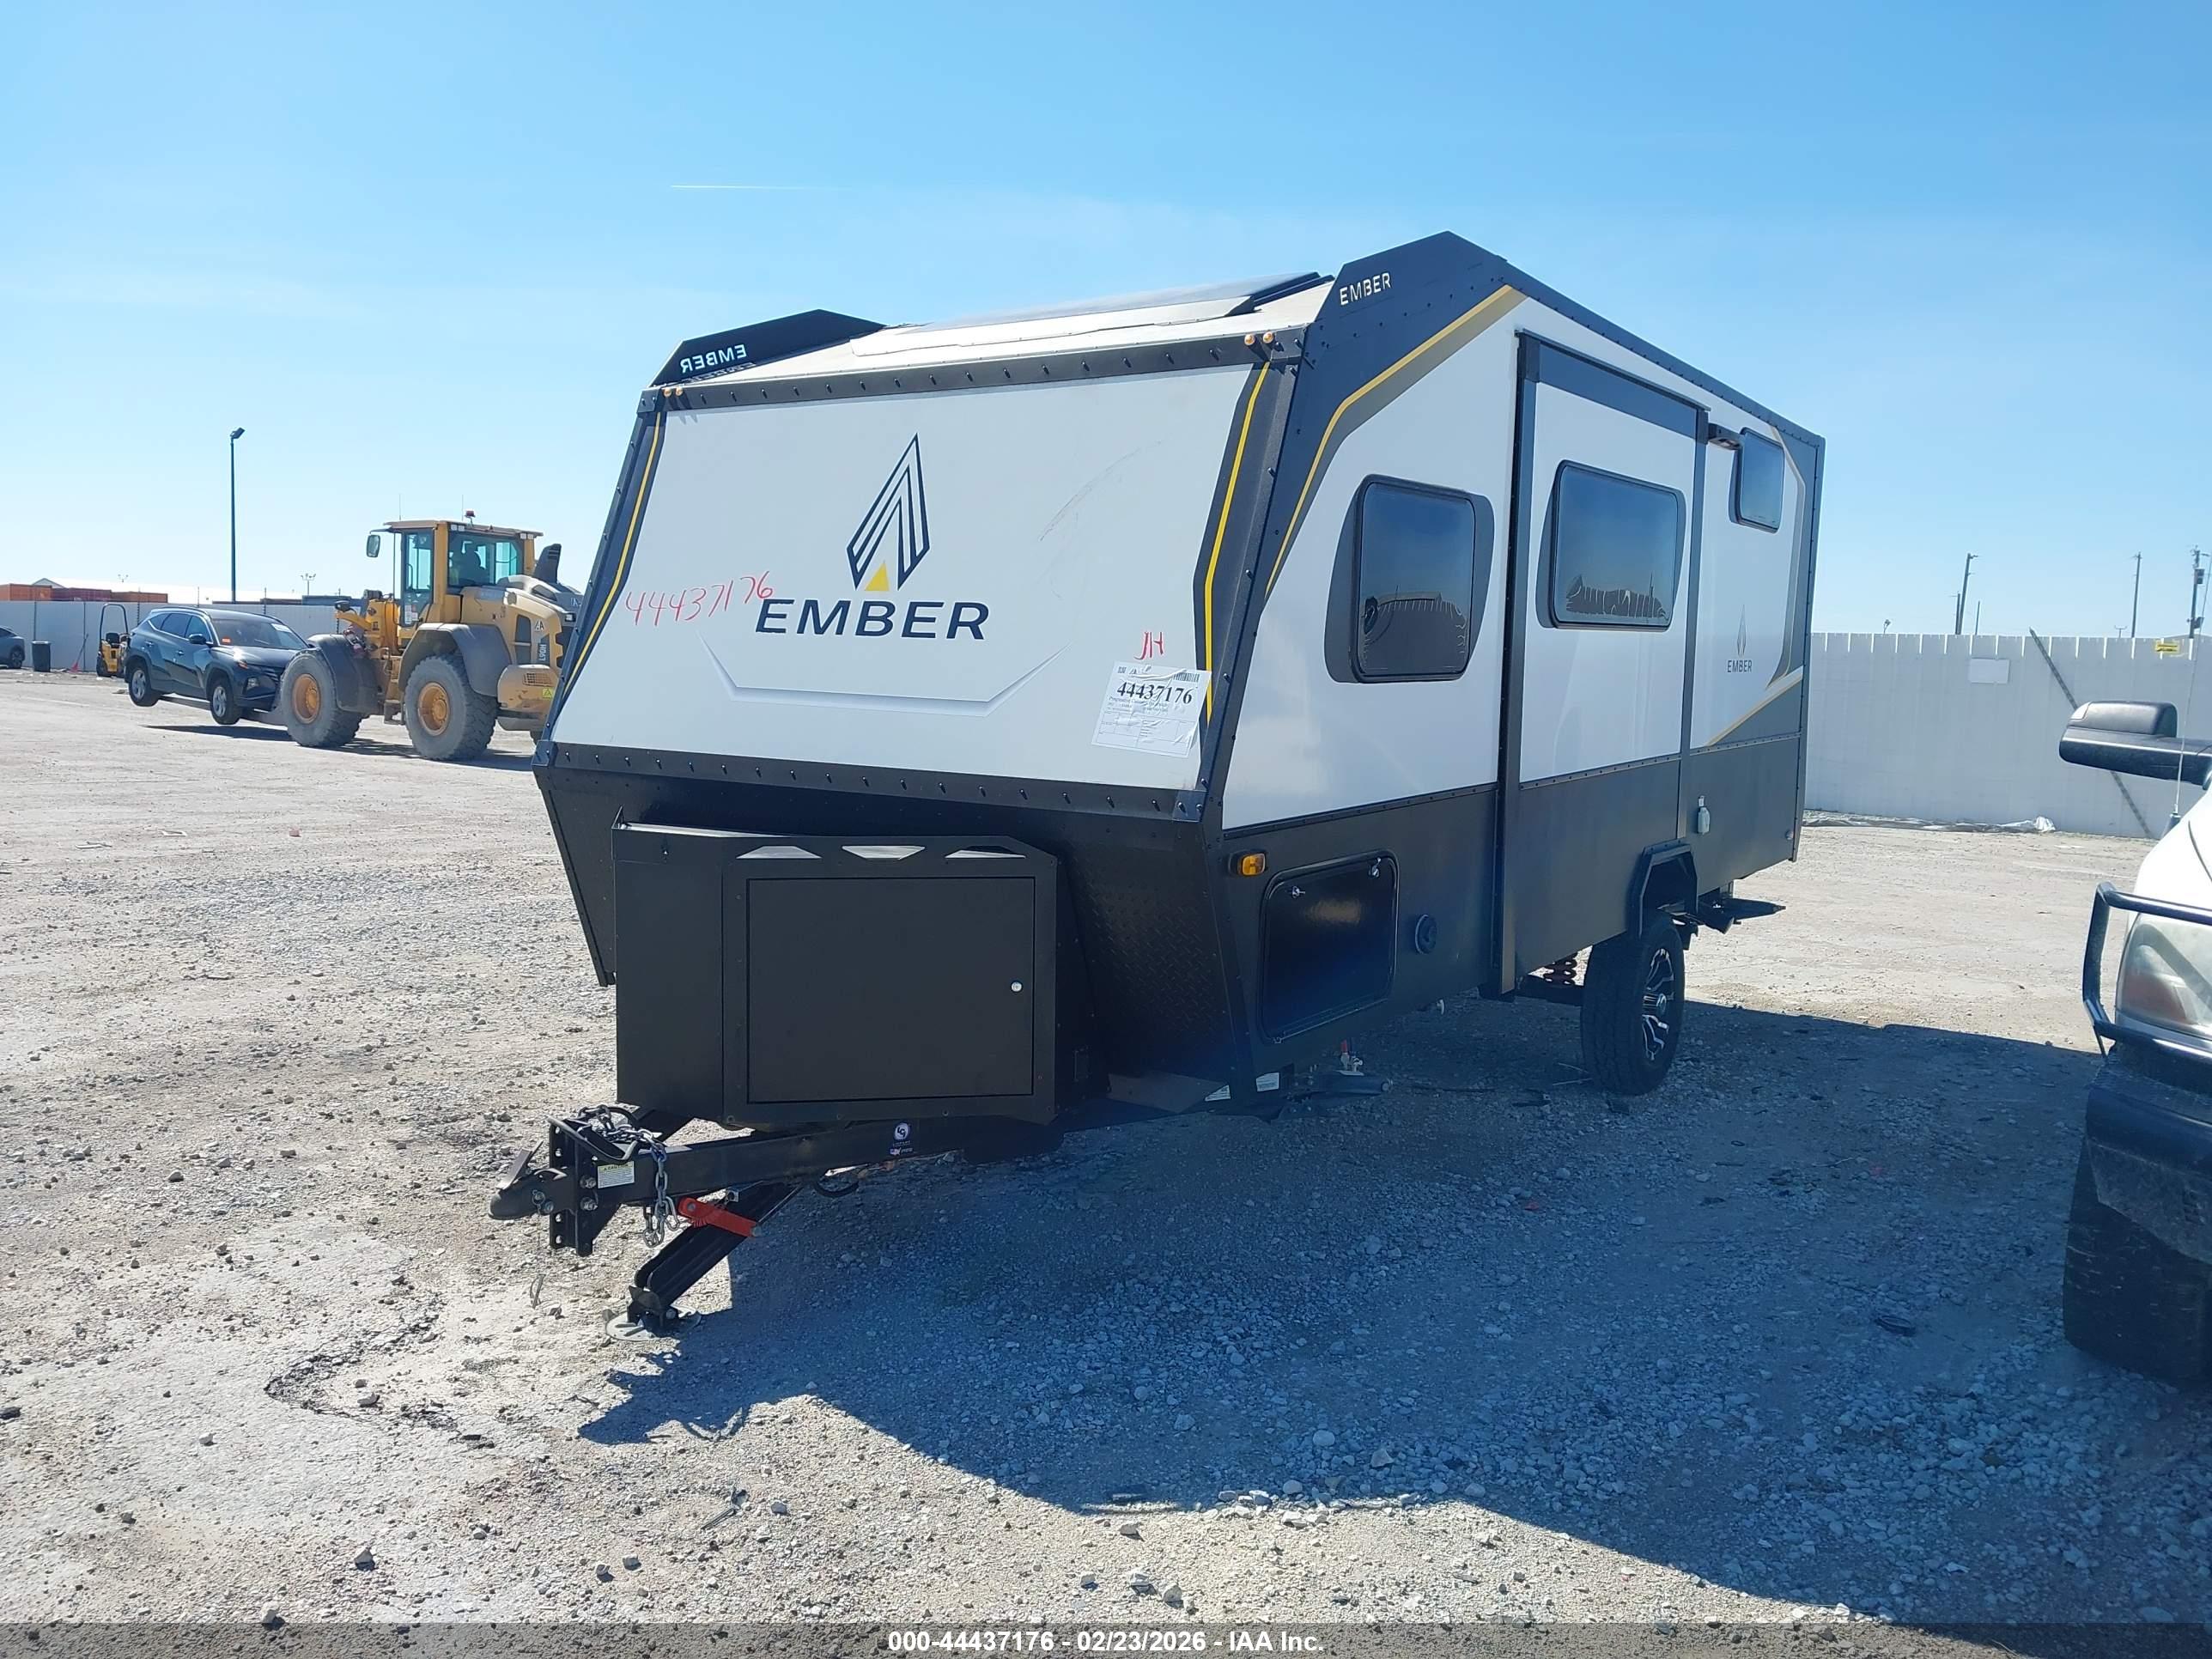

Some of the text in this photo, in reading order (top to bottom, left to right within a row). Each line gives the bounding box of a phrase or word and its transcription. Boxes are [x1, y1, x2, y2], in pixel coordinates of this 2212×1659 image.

[1340, 272, 1391, 306] EMBER
[625, 571, 774, 626] 44437176
[756, 599, 989, 641] EMBER
[1727, 659, 1753, 673] EMBER
[1117, 681, 1194, 705] 44437176
